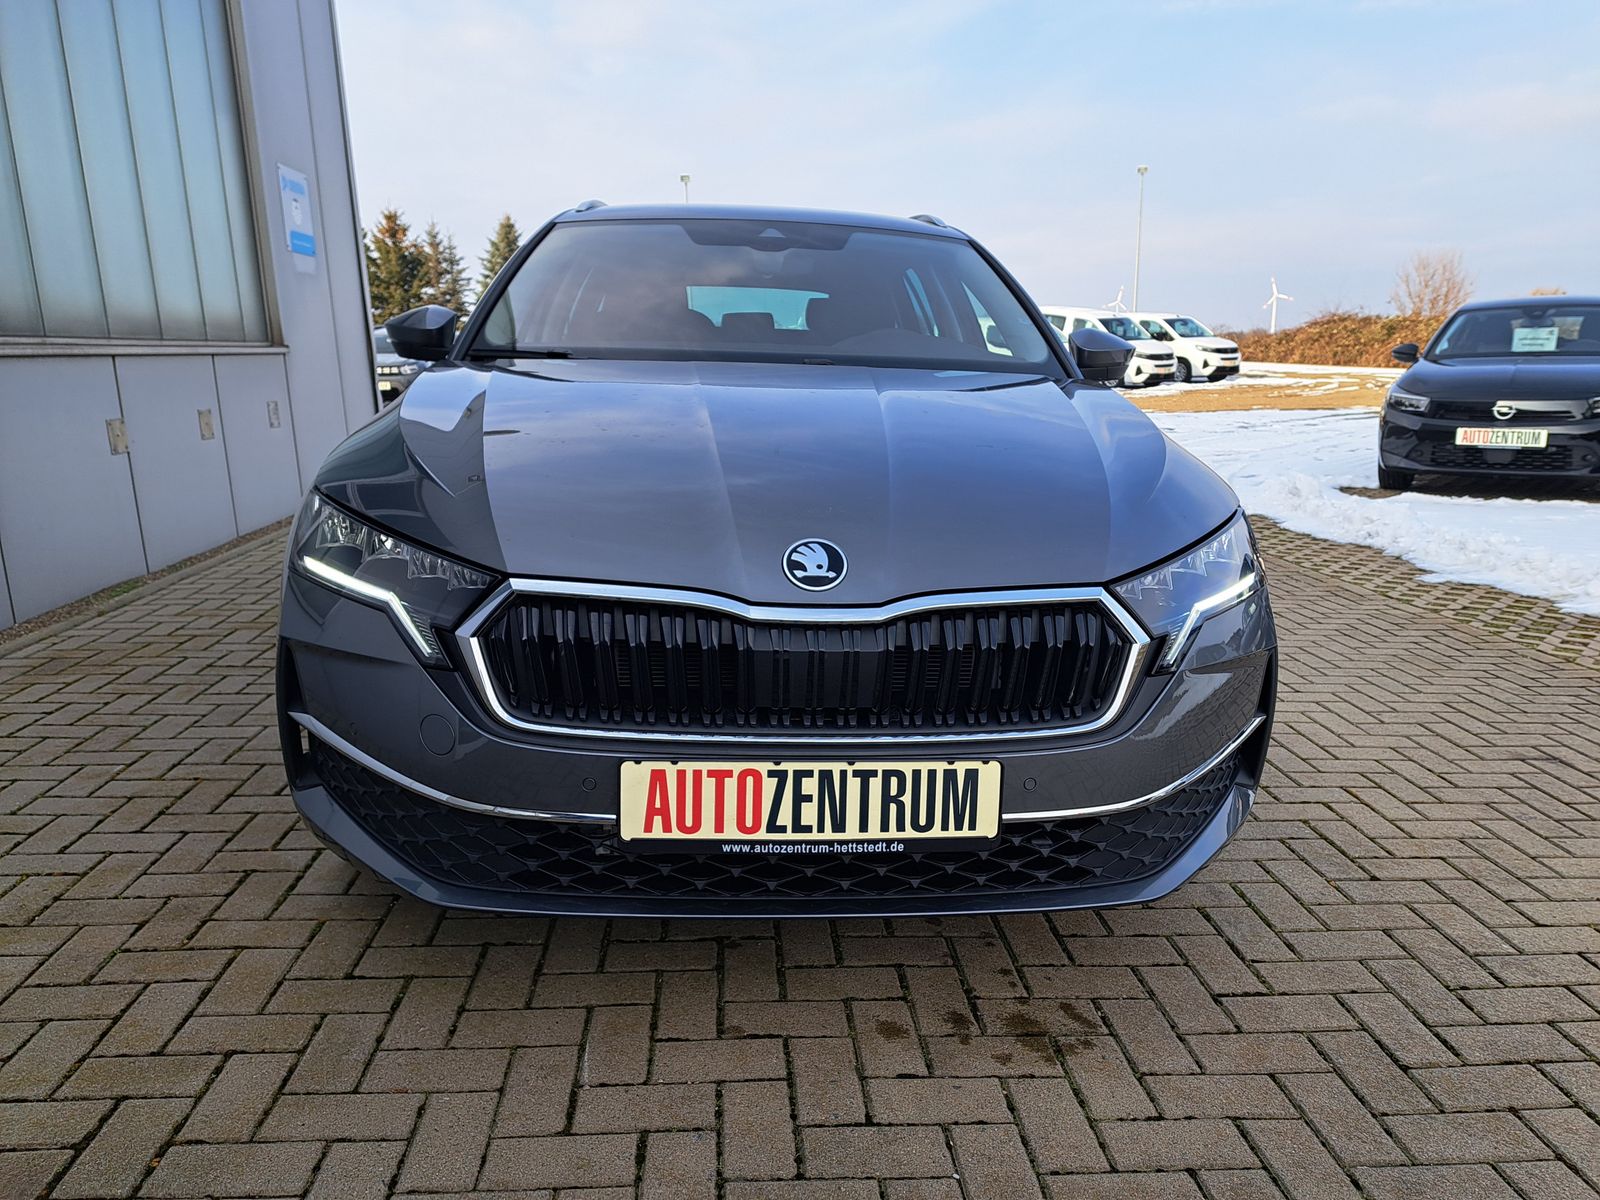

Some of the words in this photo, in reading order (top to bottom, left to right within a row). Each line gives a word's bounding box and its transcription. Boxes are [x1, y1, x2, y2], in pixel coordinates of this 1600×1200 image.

[1461, 429, 1541, 445] AUTOZENTRUM
[643, 768, 979, 835] AUTOZENTRUM
[721, 841, 905, 854] www.autozentrum-hettstedt.de
